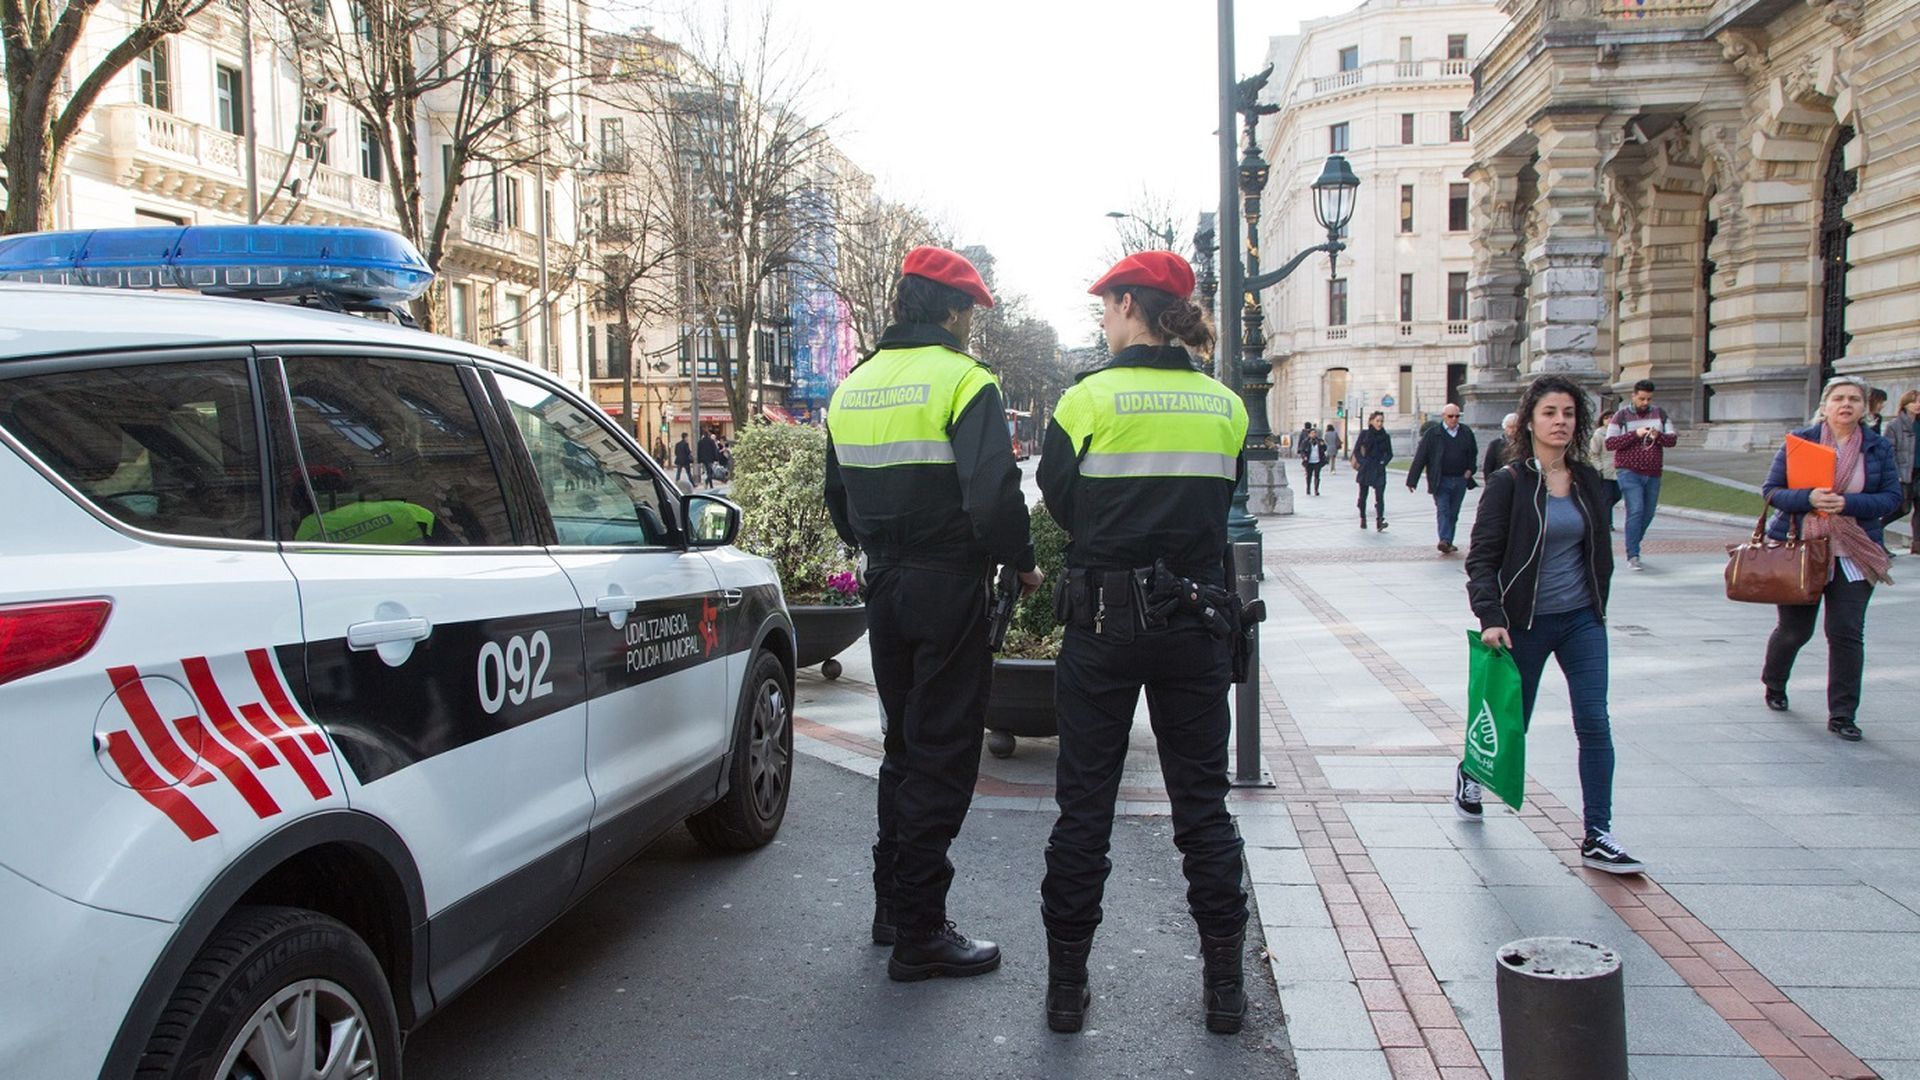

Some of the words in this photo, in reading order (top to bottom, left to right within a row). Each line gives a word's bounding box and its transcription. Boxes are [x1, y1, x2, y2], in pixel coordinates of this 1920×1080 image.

[843, 386, 924, 408] UDALTZAINGOA
[1120, 393, 1229, 414] UDALTZAINGOA
[625, 613, 689, 646] UDALTZAINGOA
[626, 644, 662, 673] POLICIA
[662, 634, 699, 663] MUNICIPAL
[477, 630, 553, 714] 092
